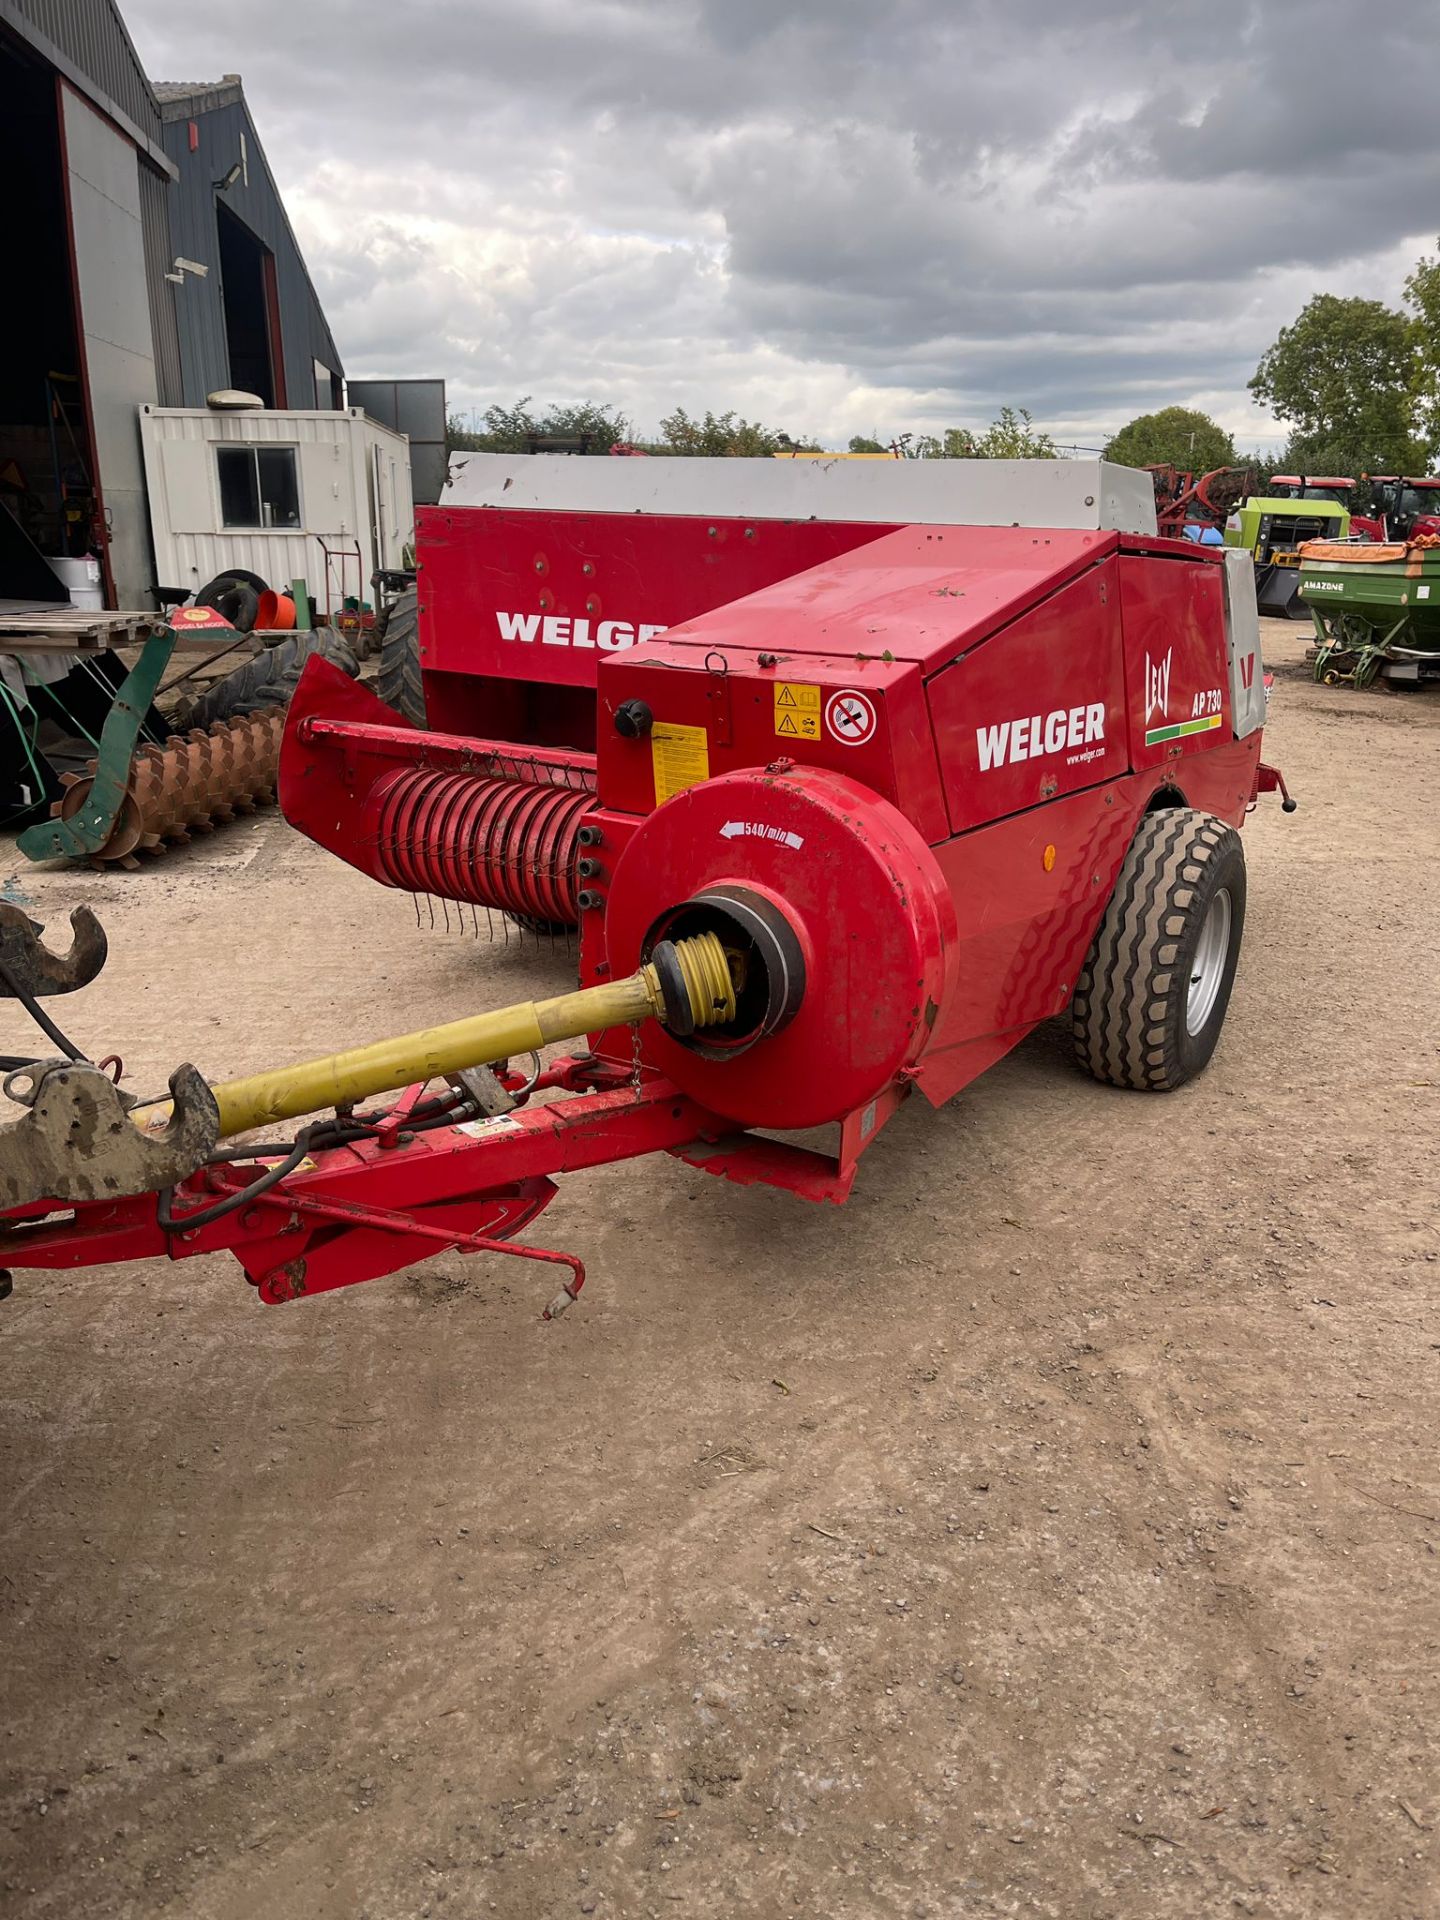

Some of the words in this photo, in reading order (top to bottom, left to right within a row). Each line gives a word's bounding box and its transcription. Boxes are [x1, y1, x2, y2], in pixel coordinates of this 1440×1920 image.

[1303, 581, 1344, 591] AMAZONE
[1145, 646, 1172, 726] LELY
[1191, 692, 1206, 718] AP
[1207, 688, 1222, 713] 730
[976, 702, 1105, 772] WELGER
[1066, 747, 1105, 765] www.welger.com
[745, 822, 787, 843] 540/min
